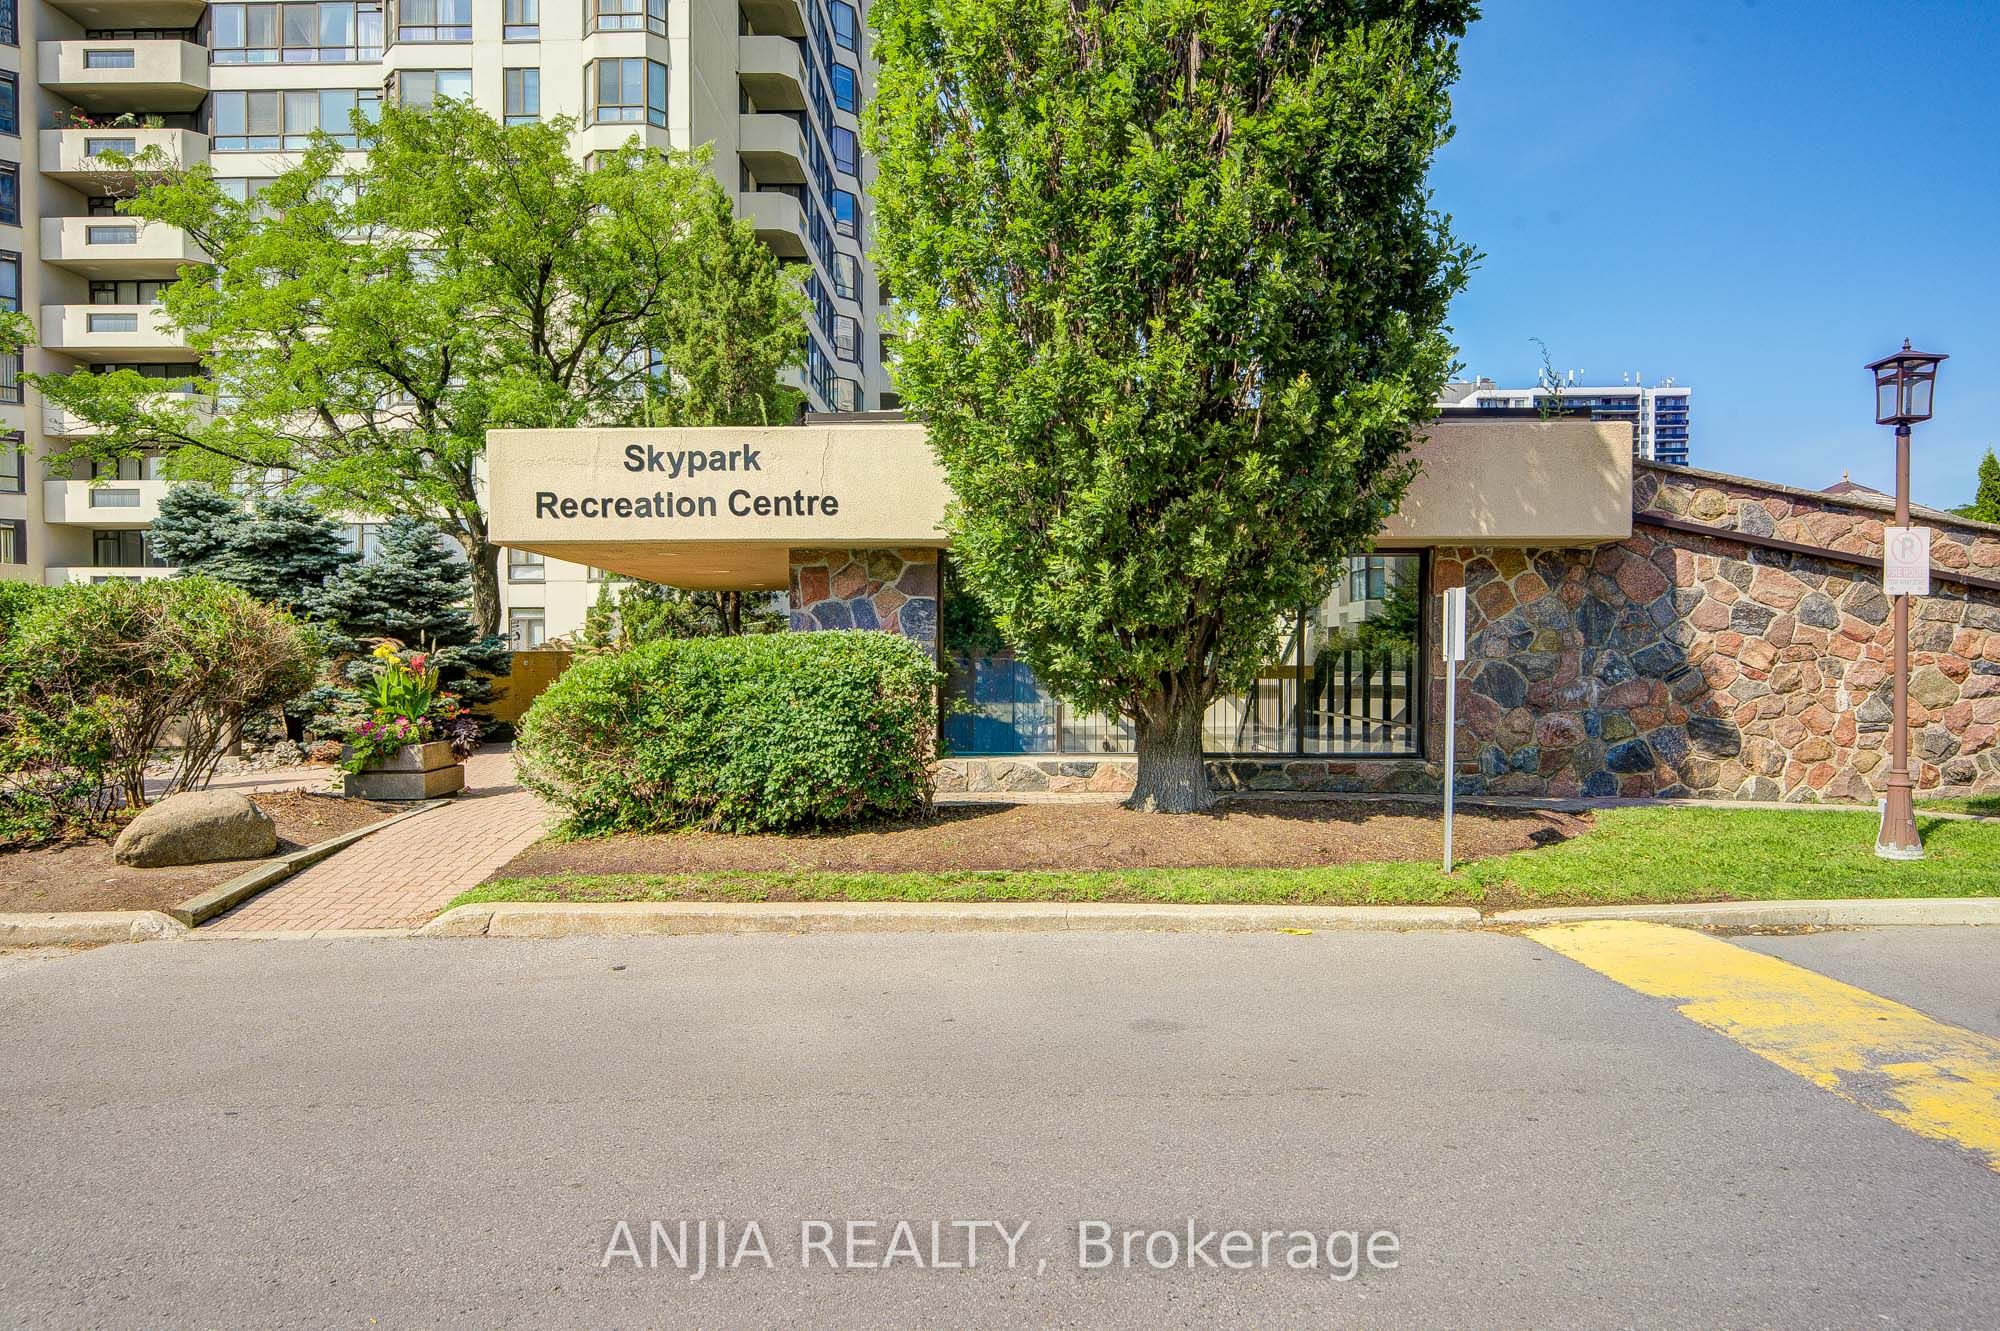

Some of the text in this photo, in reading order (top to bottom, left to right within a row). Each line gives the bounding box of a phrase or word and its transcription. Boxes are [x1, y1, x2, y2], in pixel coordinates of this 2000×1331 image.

[623, 443, 762, 479] Skypark
[535, 489, 839, 519] Recreation Centre
